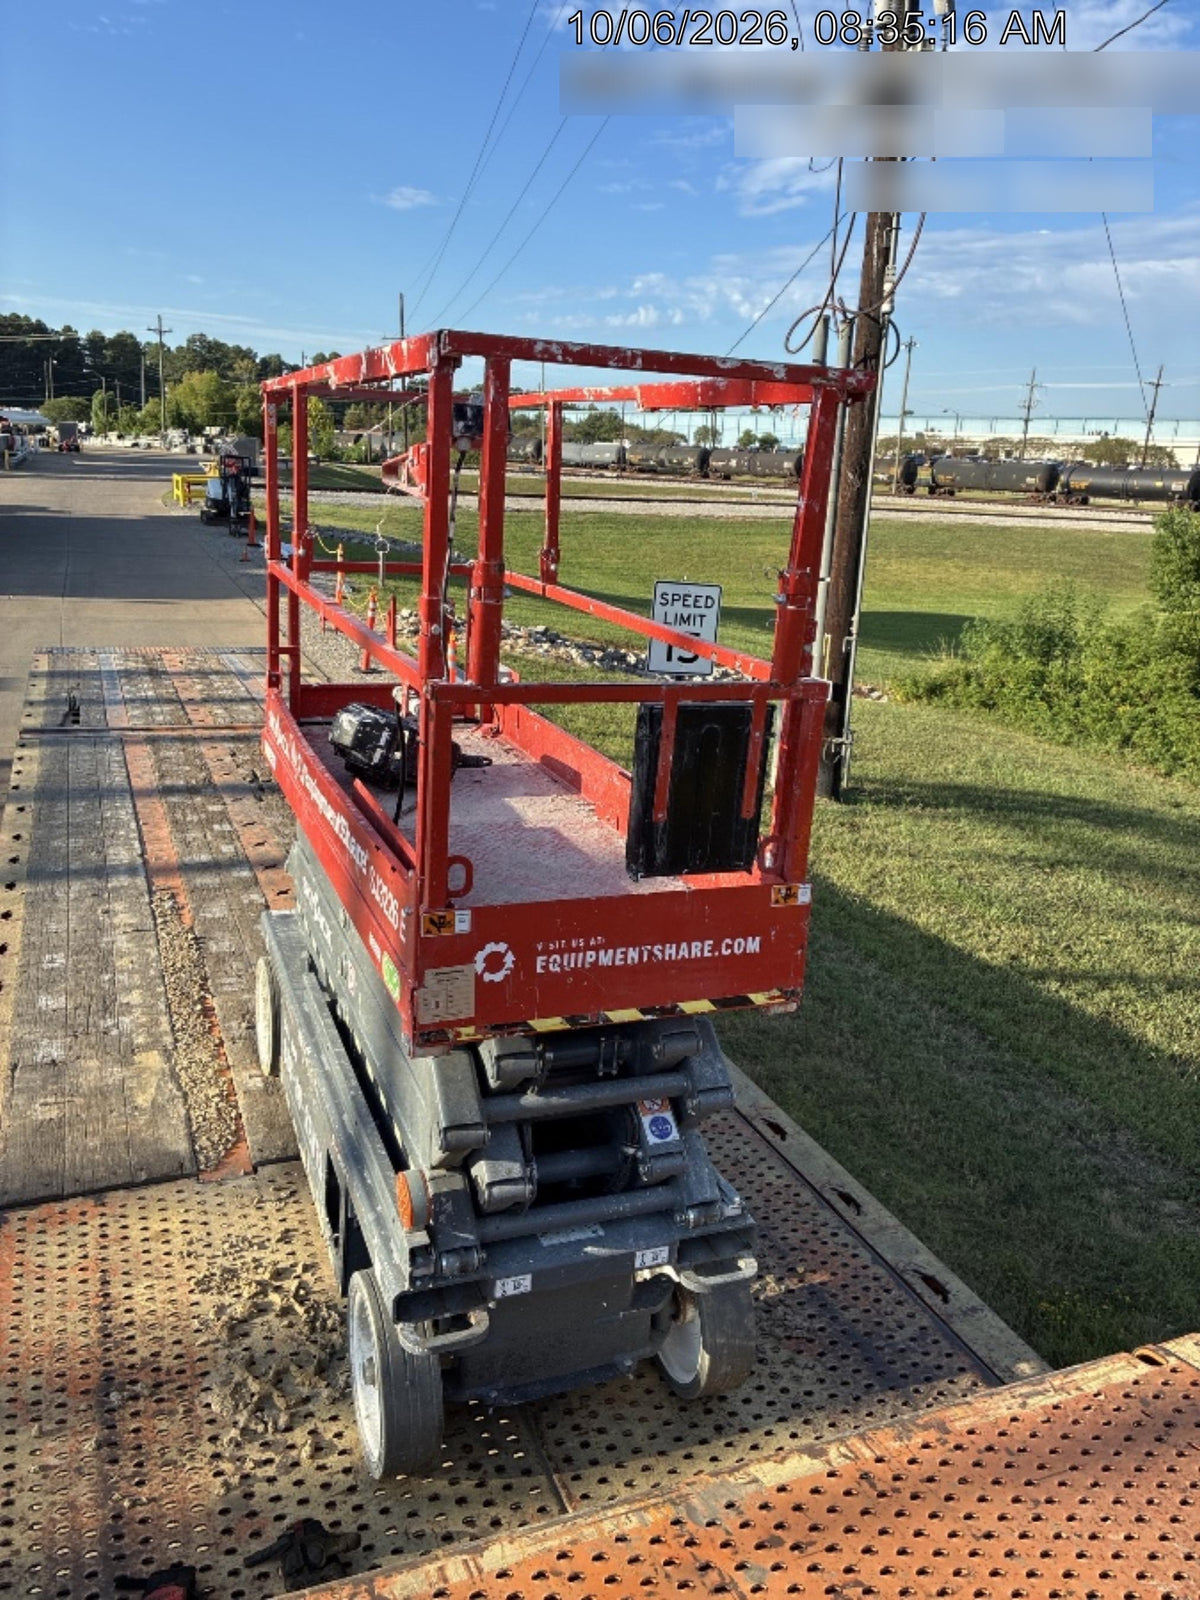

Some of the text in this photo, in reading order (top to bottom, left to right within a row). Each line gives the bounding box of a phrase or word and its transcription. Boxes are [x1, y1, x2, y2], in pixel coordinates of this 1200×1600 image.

[659, 592, 715, 609] SPEED
[663, 611, 707, 628] LIMIT
[536, 940, 567, 952] VSIT
[571, 938, 585, 949] US
[536, 936, 761, 974] EQUIPMENTSHARE.COM
